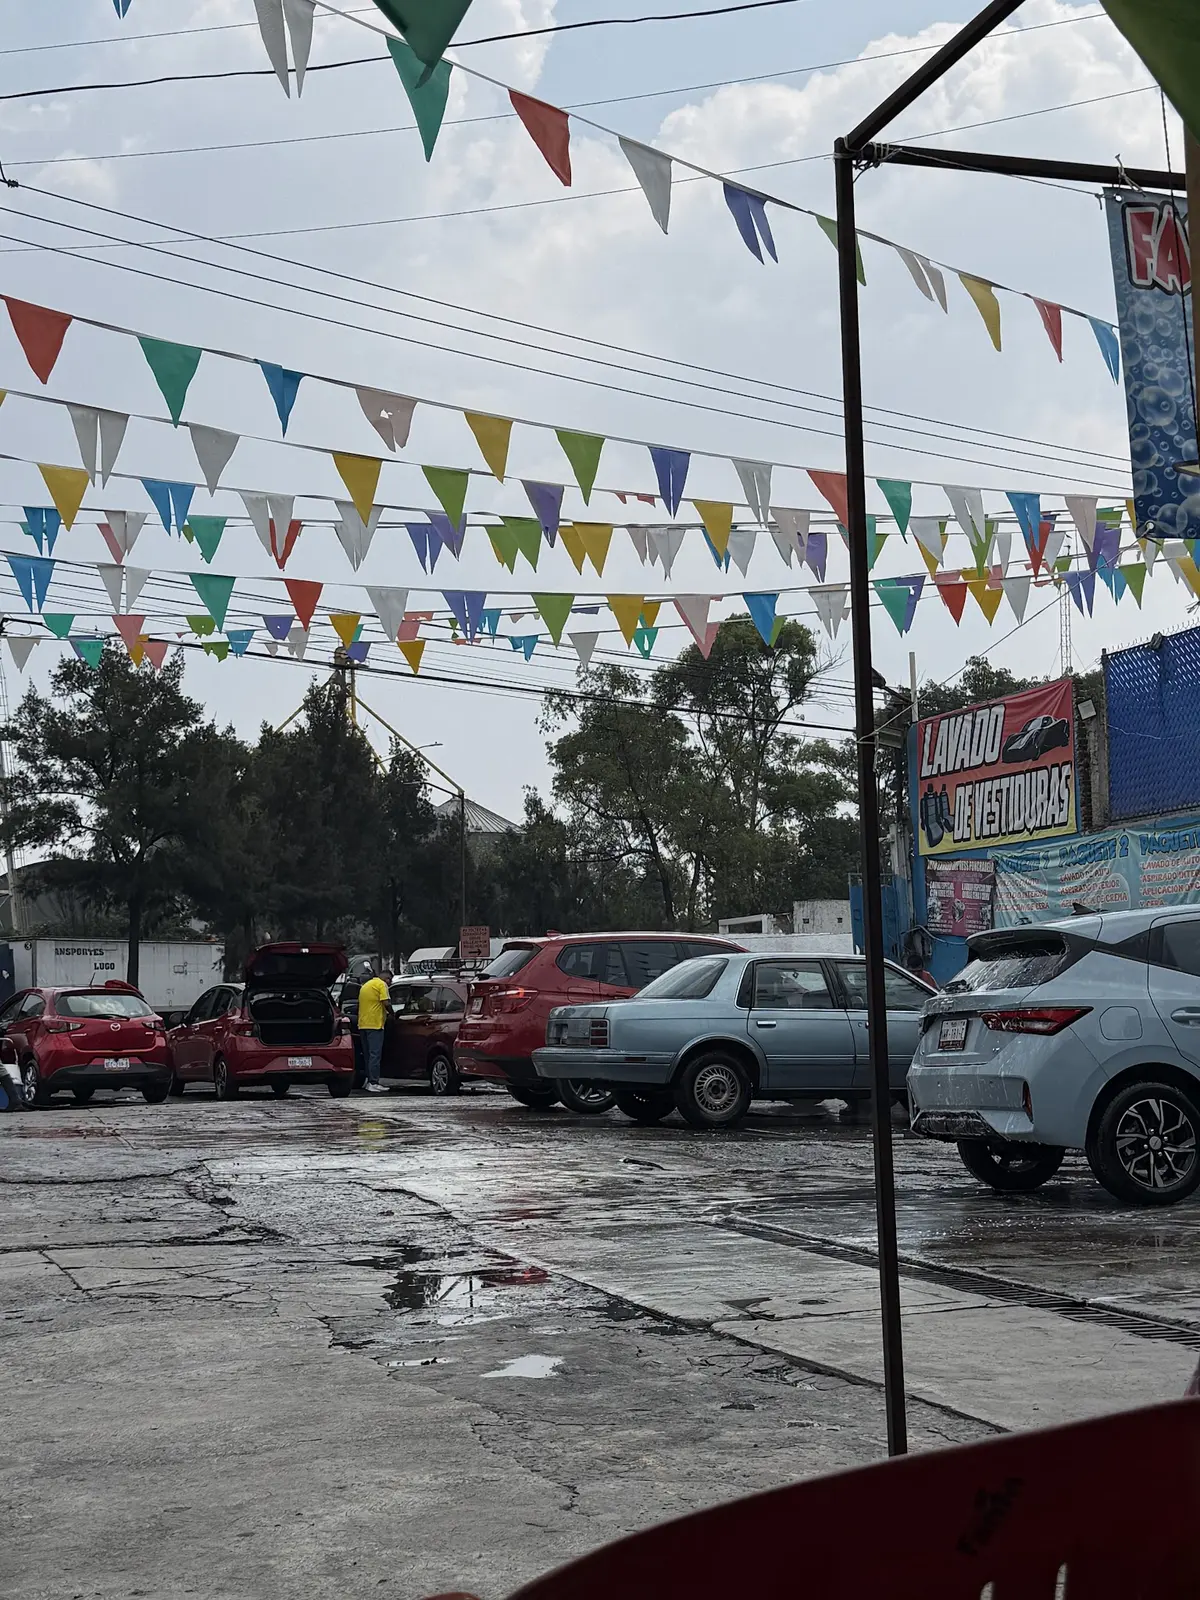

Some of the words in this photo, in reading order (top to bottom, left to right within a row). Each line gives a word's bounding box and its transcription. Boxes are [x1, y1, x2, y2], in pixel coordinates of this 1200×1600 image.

[1121, 201, 1192, 296] FA
[920, 703, 1006, 780] LAVADO
[953, 781, 973, 842] DE
[974, 761, 1073, 840] VESTIDURAS
[1058, 837, 1117, 867] PAQUETE
[1119, 835, 1130, 858] 2
[1141, 859, 1170, 870] LAVADO
[1060, 871, 1085, 883] LAVADO
[1142, 871, 1177, 883] ASPIRADO
[1105, 892, 1128, 903] CREMA
